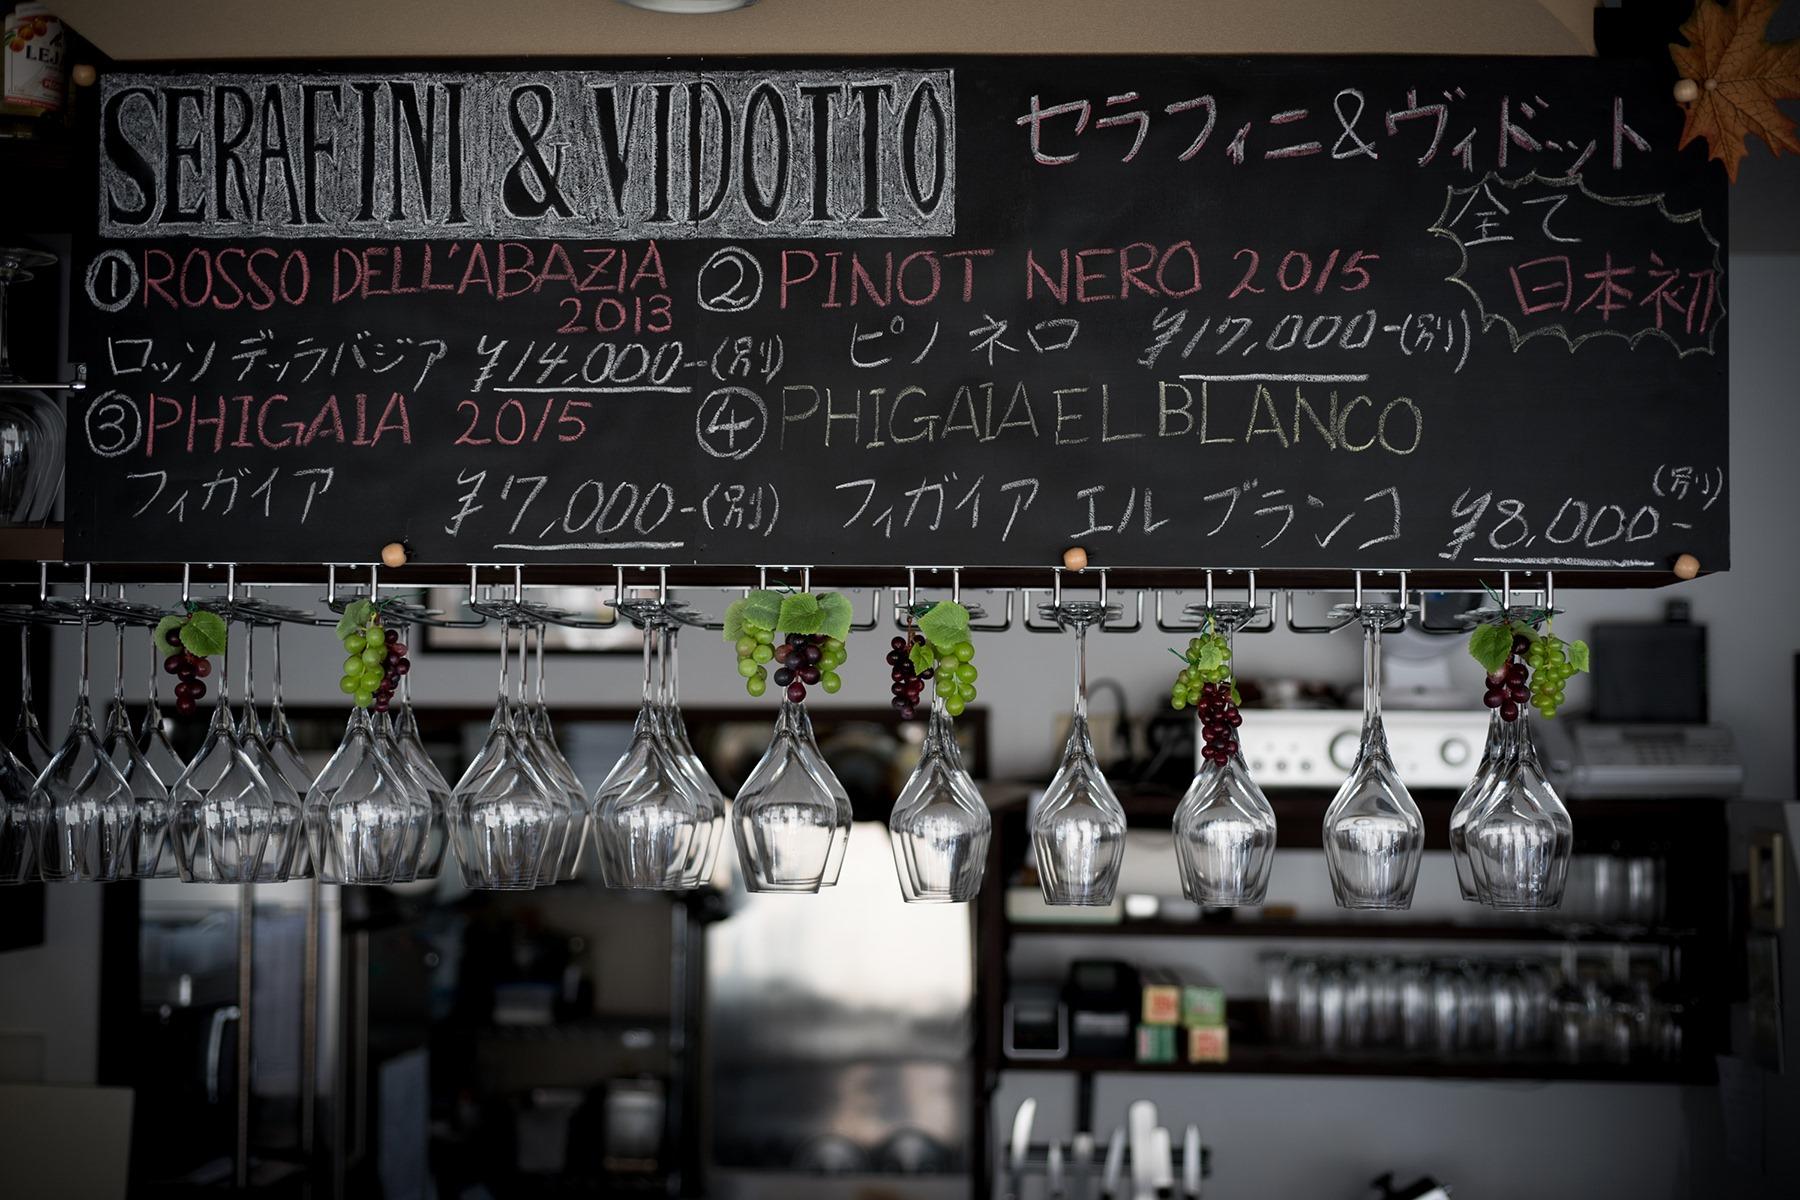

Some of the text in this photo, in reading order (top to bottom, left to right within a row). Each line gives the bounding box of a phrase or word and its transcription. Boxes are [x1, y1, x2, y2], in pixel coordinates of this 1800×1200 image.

[26, 45, 64, 66] LEJ
[101, 80, 950, 227] SERAFINI & VIDOTTO
[143, 247, 310, 312] ROSSO
[779, 249, 995, 310] PINOT
[1025, 240, 1203, 304] NERO
[1228, 248, 1380, 299] 2015
[1508, 252, 1717, 335] 日本初
[556, 294, 673, 336] 2013
[145, 391, 413, 457] PHIGAIA
[453, 398, 593, 445] 2015
[1157, 379, 1424, 456] BLANCO
[126, 465, 336, 525] フィガイア
[834, 472, 1041, 543] フィガイア
